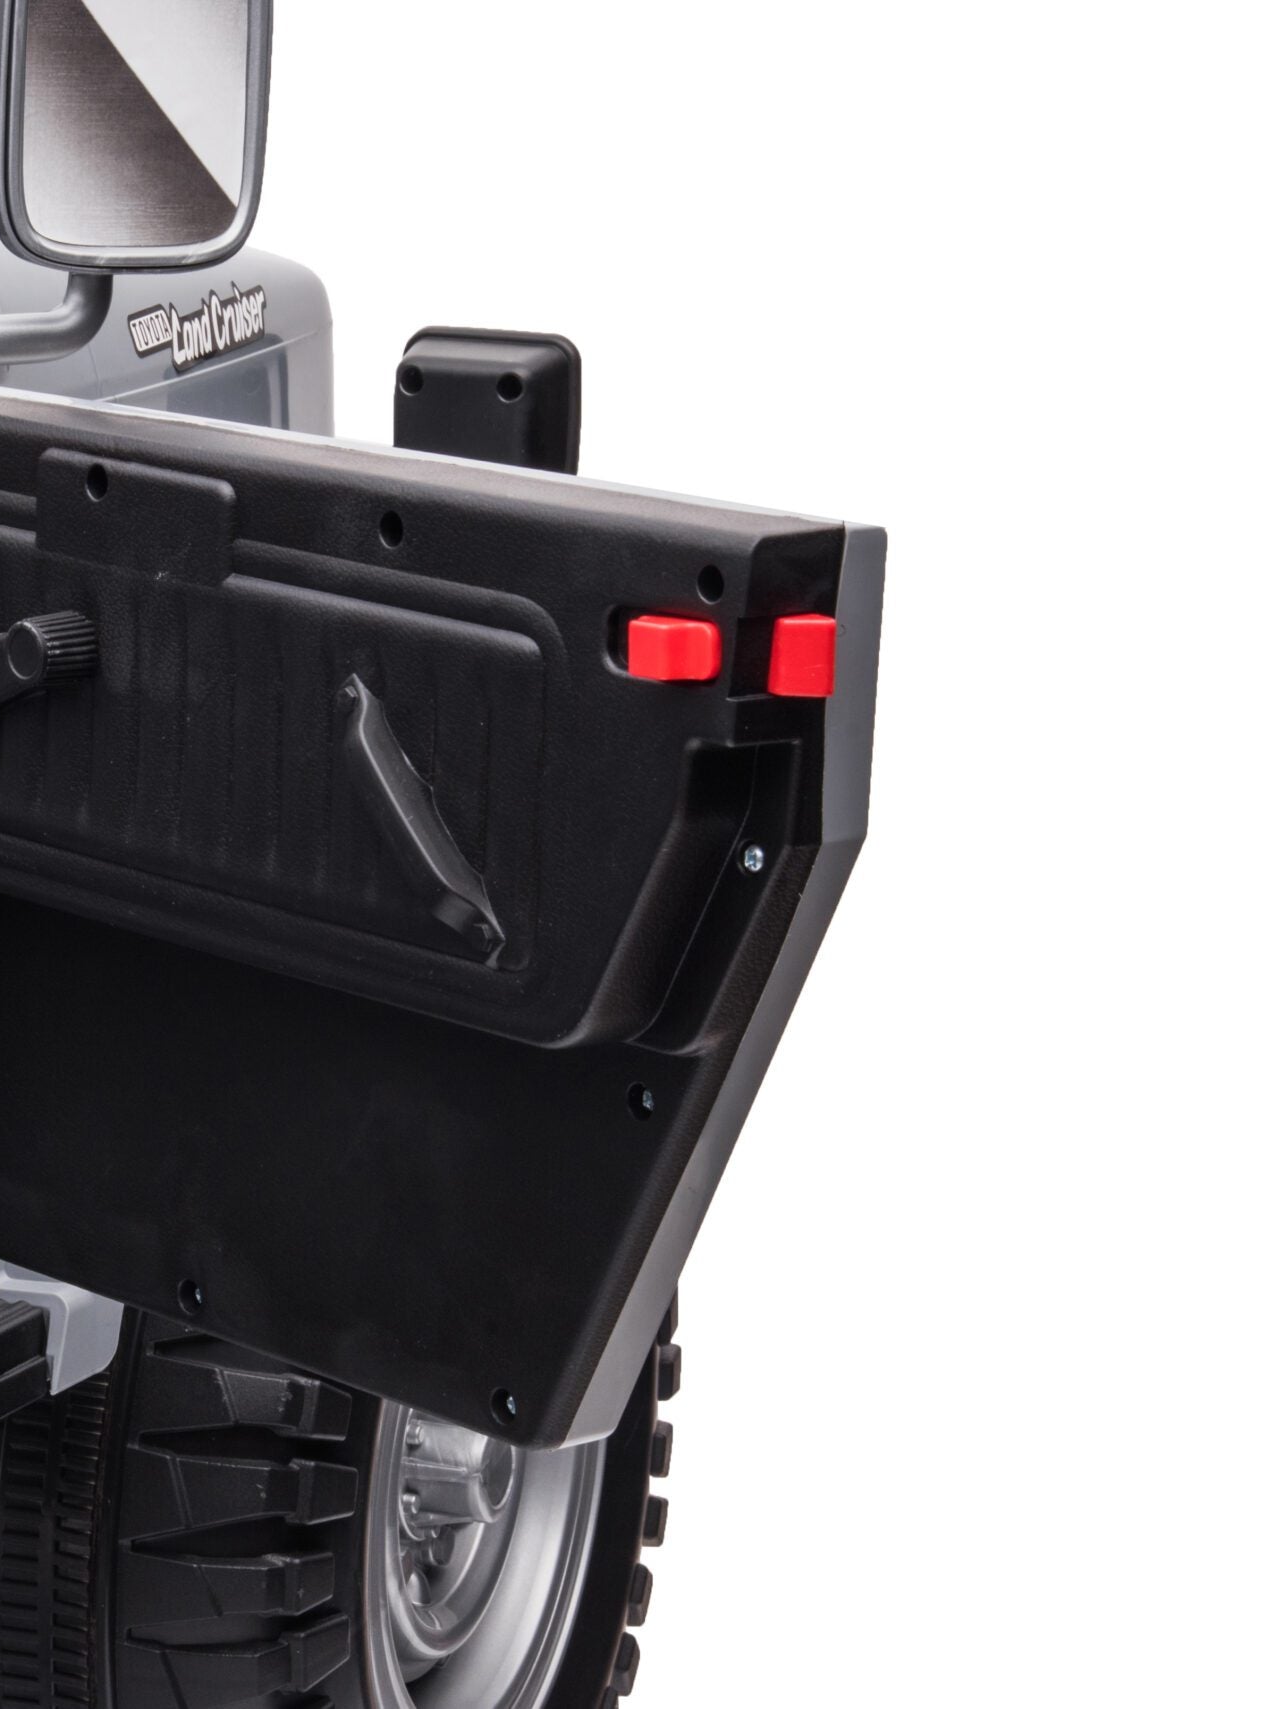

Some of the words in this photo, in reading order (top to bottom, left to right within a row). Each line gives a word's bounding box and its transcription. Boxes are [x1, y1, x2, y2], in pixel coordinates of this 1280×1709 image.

[130, 311, 172, 350] TOYOTA
[171, 302, 213, 364] Land
[210, 286, 265, 351] Cruiser
